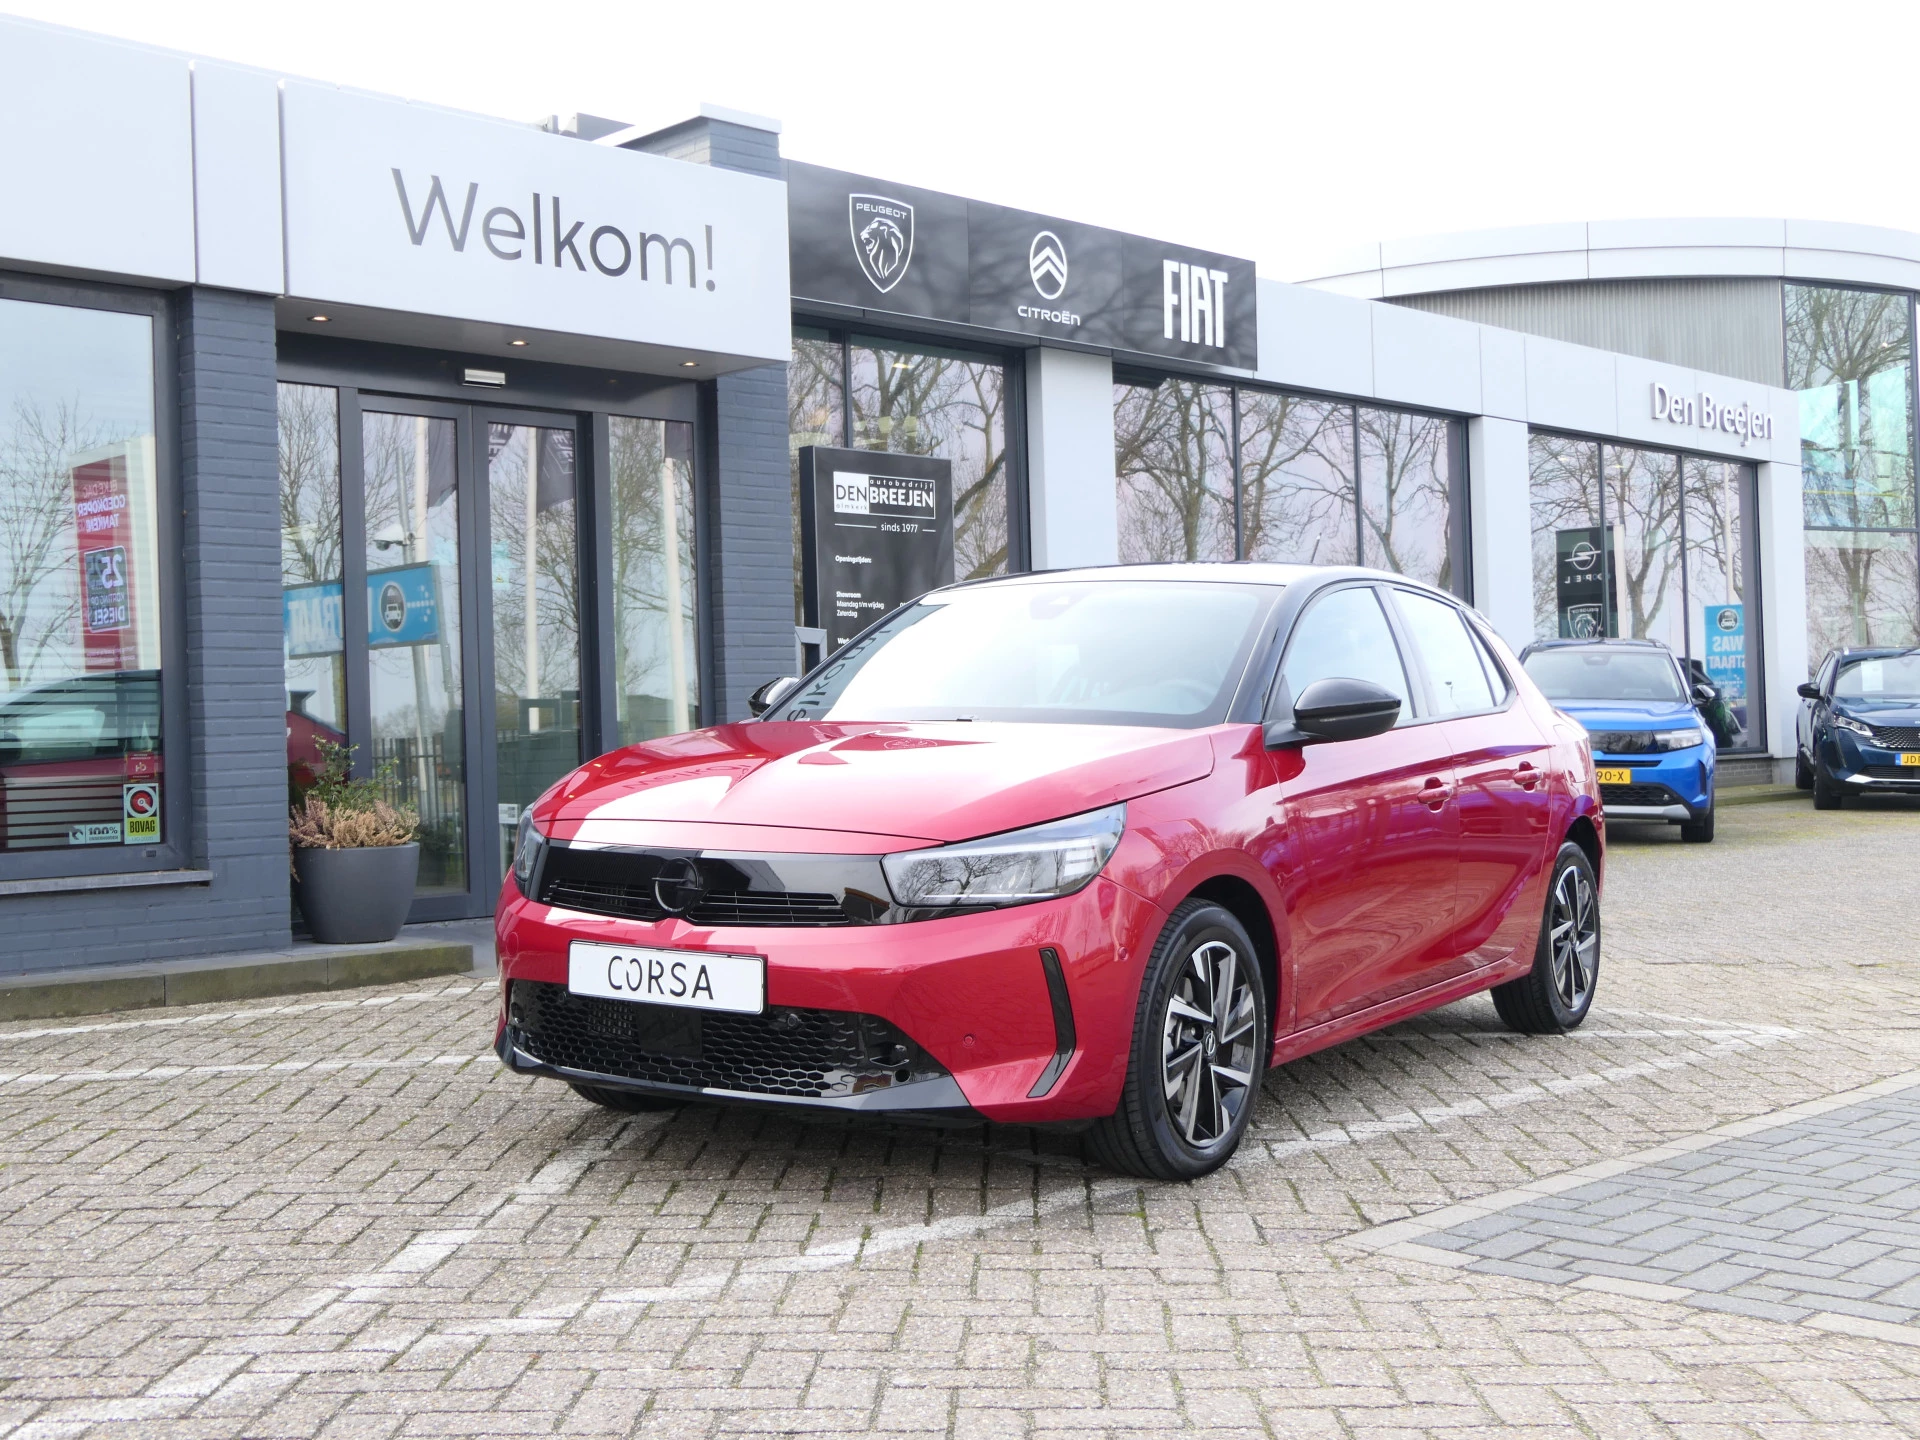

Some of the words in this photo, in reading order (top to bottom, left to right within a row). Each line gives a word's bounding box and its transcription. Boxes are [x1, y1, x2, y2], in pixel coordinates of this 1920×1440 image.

[855, 201, 908, 220] PEUGEOT
[391, 168, 716, 292] Welkom!
[1017, 304, 1081, 326] CITROËN
[1163, 259, 1228, 348] FIAT
[1650, 382, 1696, 426] Den
[1698, 391, 1775, 448] Breejen
[869, 478, 934, 490] autobedrijf
[835, 484, 868, 502] DEN
[869, 486, 934, 509] BREEJEN
[880, 521, 900, 533] sinds
[902, 522, 919, 534] 1977
[129, 819, 156, 834] BOVAG
[607, 955, 714, 1000] CORSA
